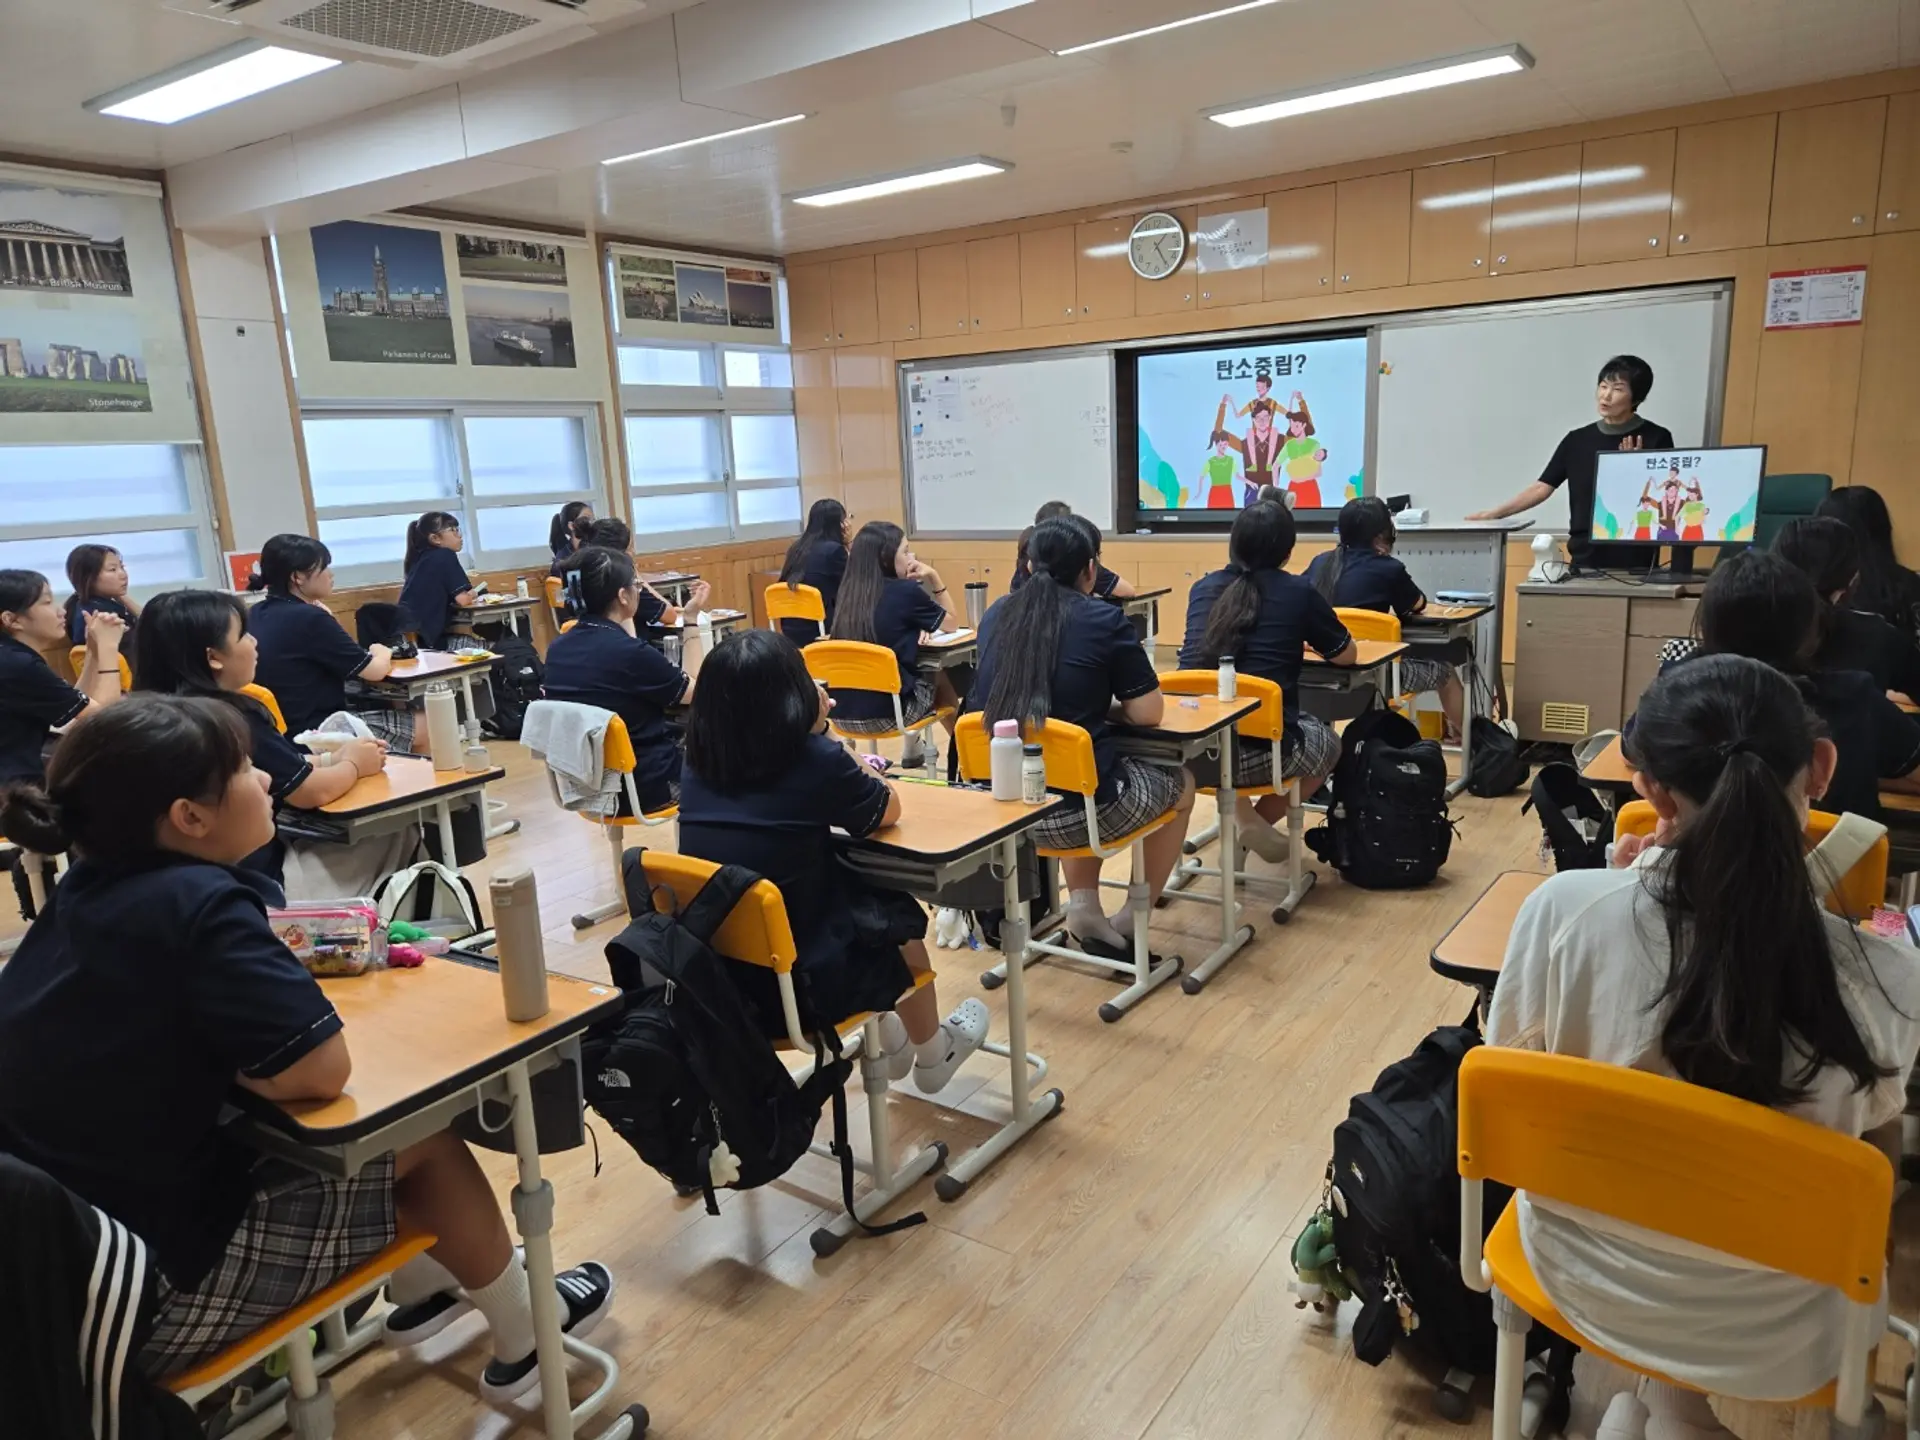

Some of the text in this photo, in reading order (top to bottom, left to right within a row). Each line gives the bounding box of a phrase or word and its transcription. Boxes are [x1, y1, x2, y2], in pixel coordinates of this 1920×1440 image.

[1171, 251, 1177, 260] 4
[1145, 262, 1152, 271] 7
[49, 278, 123, 290] British Museum
[382, 350, 451, 360] Parliament of Canada
[1216, 354, 1307, 380] 탄소중립?
[88, 398, 144, 408] Stonehenge
[1646, 456, 1701, 469] 탄소중립?
